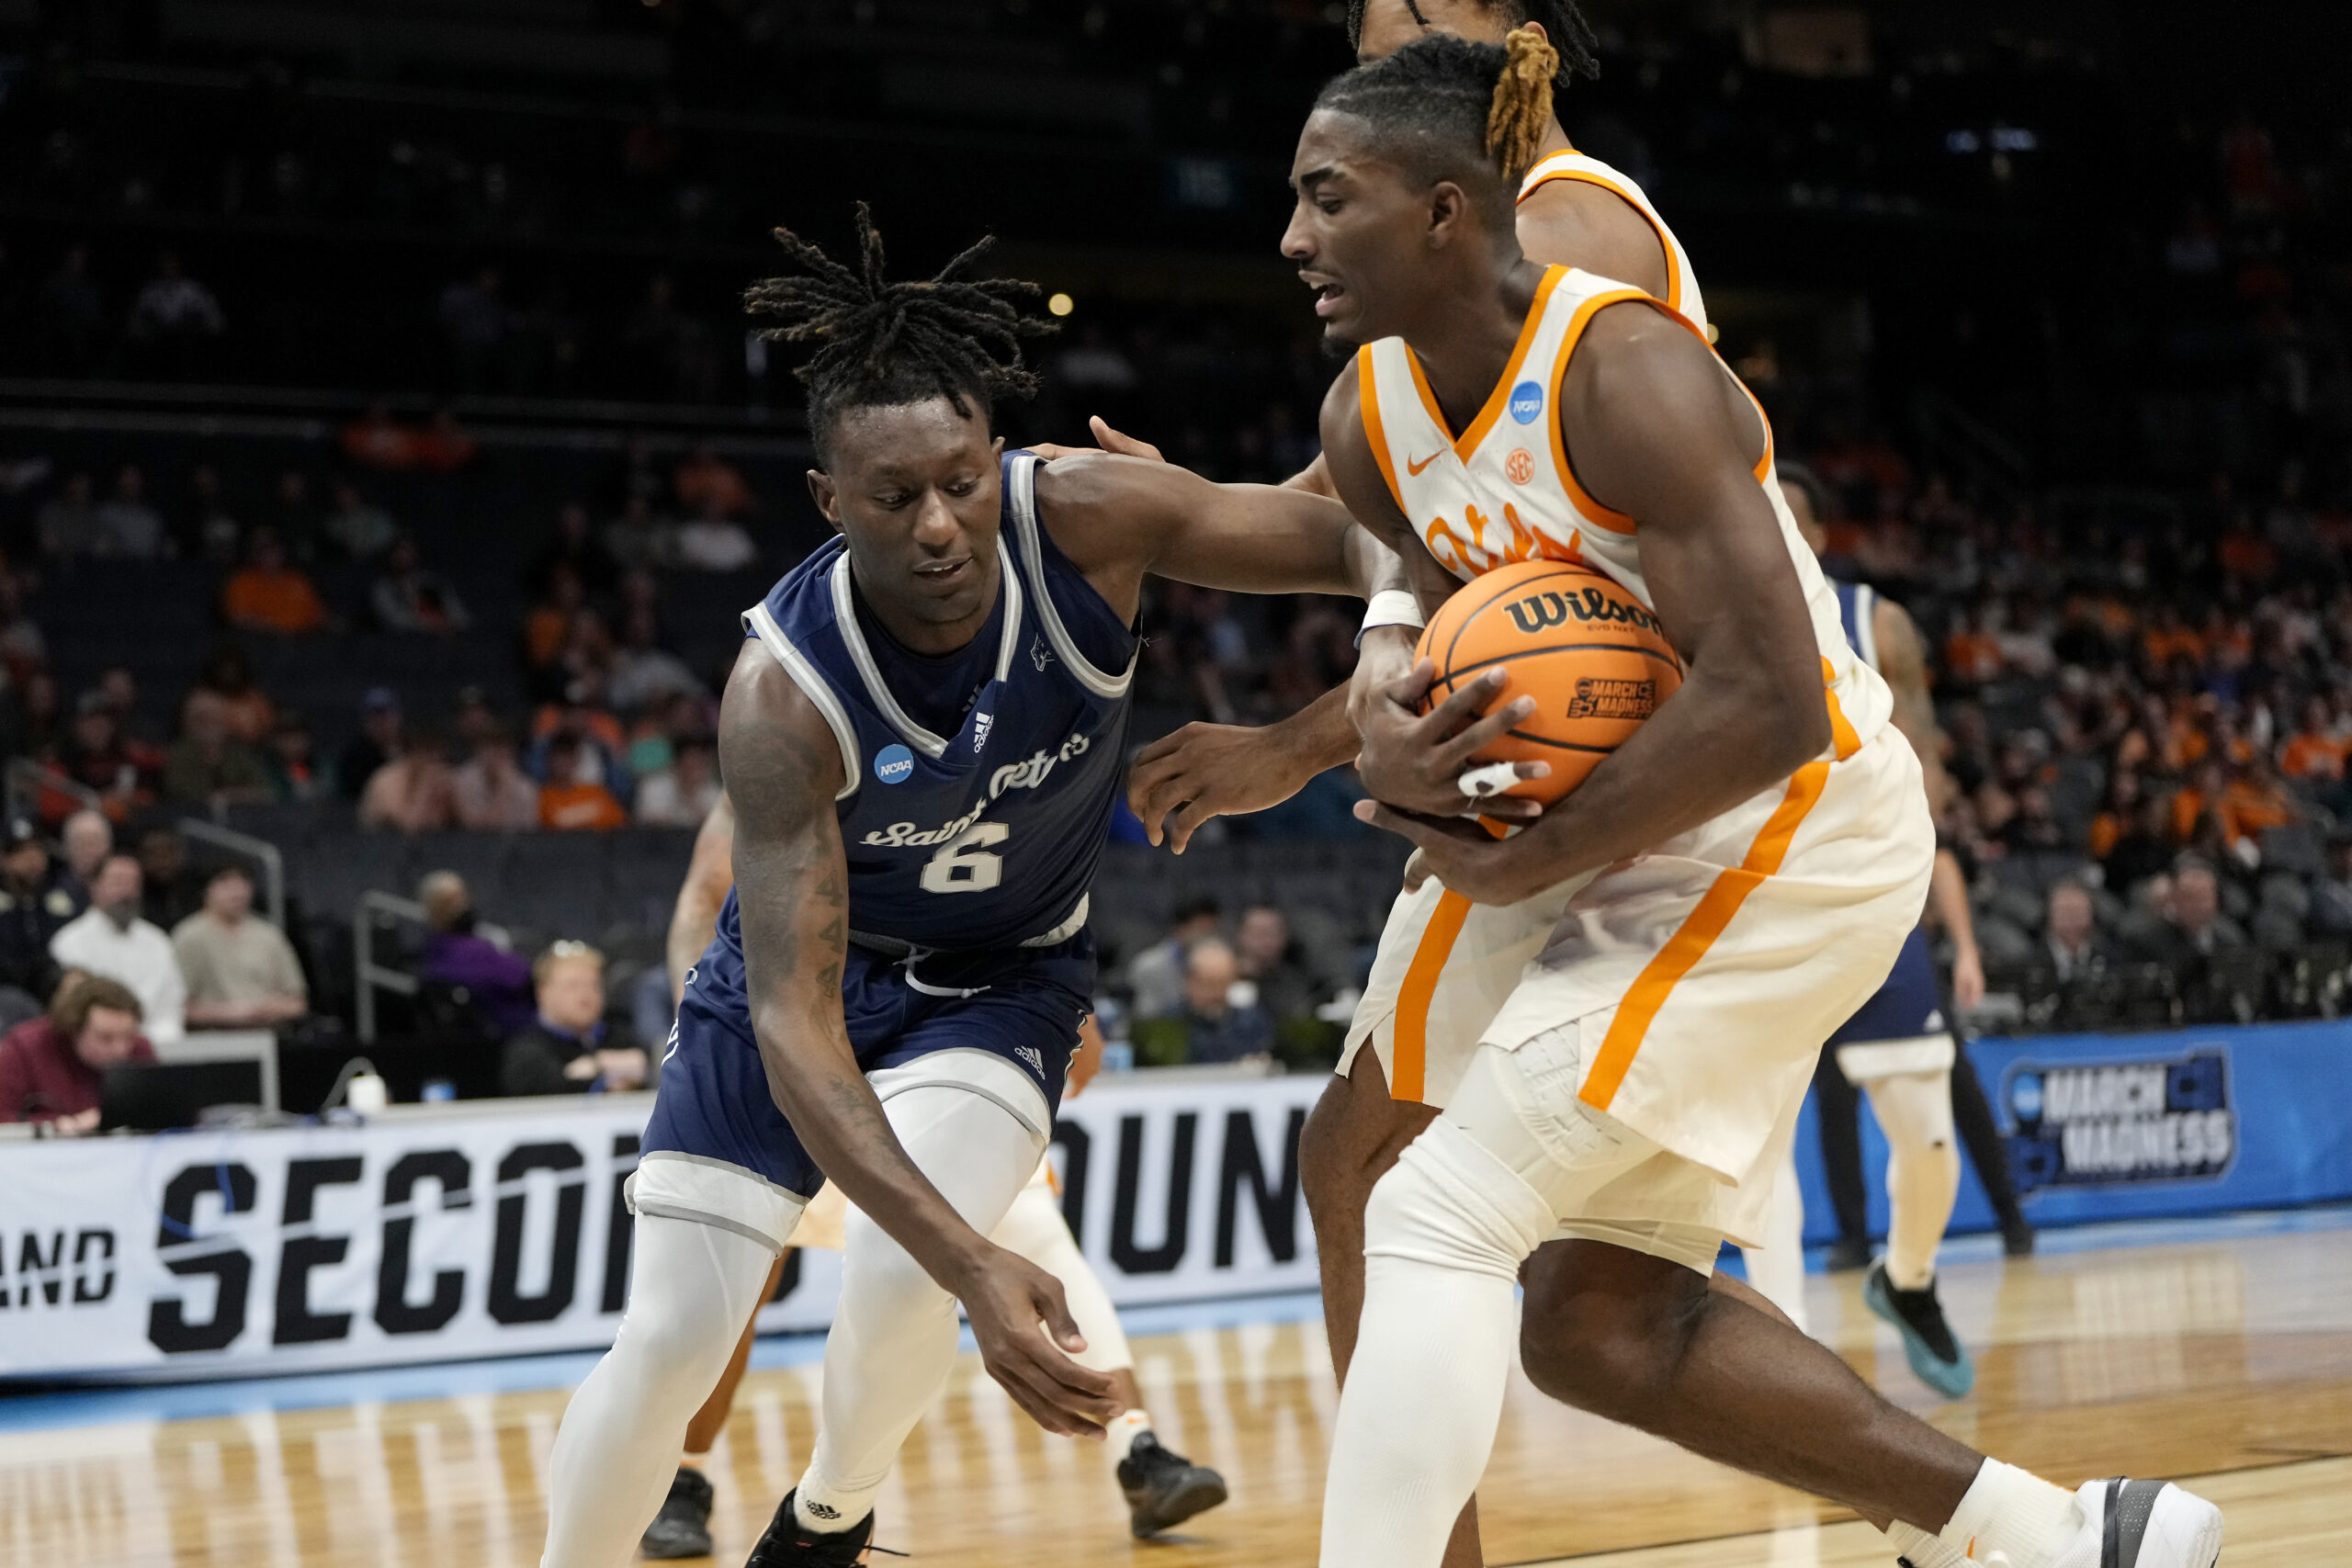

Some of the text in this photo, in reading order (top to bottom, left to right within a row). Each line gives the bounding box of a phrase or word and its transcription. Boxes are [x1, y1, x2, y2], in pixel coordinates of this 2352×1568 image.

[1508, 453, 1532, 480] SEC
[1503, 587, 1667, 640] Wilson
[1591, 680, 1638, 698] MARCH
[1596, 698, 1654, 716] MADNESS
[973, 714, 995, 754] adidas
[880, 759, 913, 778] NCAA
[919, 821, 1010, 895] 6
[1013, 1045, 1046, 1081] adidas
[0, 1231, 115, 1308] ND
[147, 1134, 802, 1355] SECO
